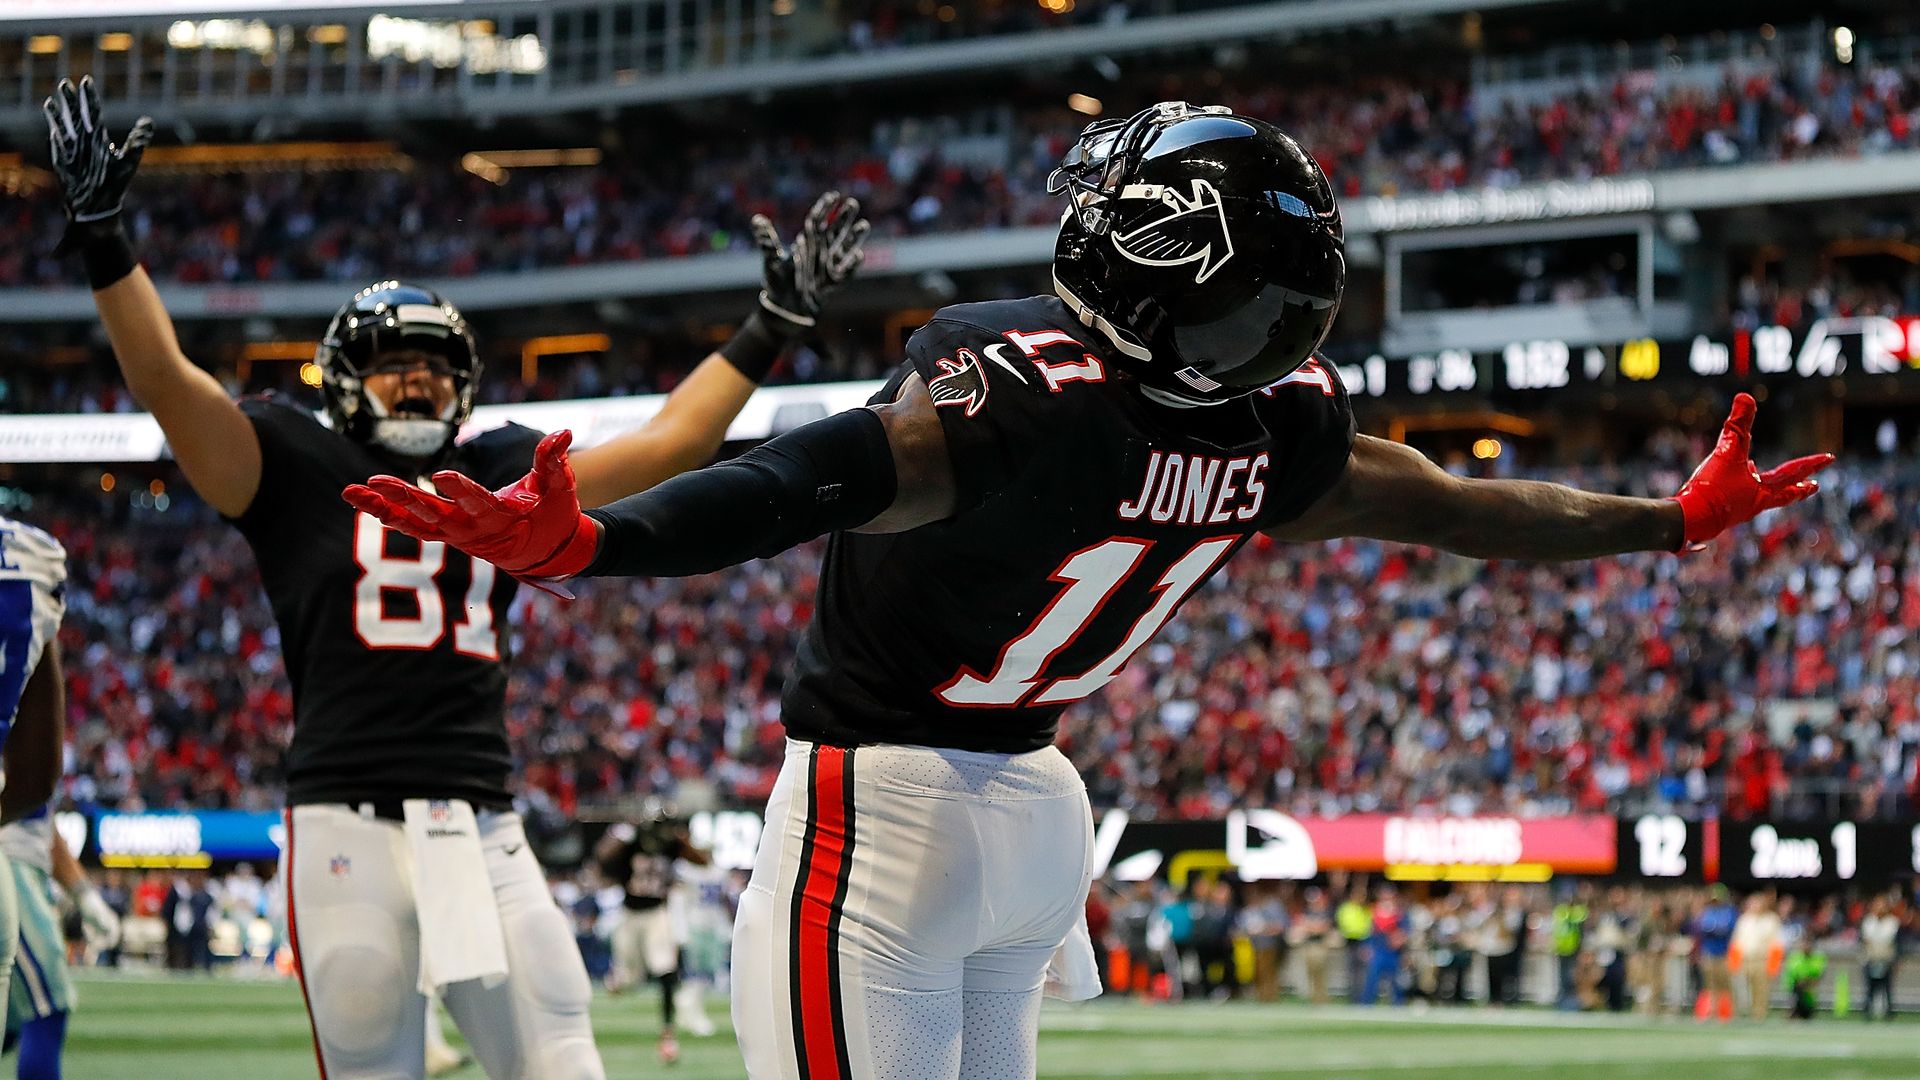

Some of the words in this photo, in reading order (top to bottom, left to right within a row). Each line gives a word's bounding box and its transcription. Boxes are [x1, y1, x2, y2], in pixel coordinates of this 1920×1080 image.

[1001, 328, 1106, 393] 11
[1119, 450, 1270, 525] JONES
[353, 510, 500, 662] 81
[931, 533, 1244, 708] 11
[1384, 816, 1523, 865] FALCONS
[1634, 814, 1687, 877] 12
